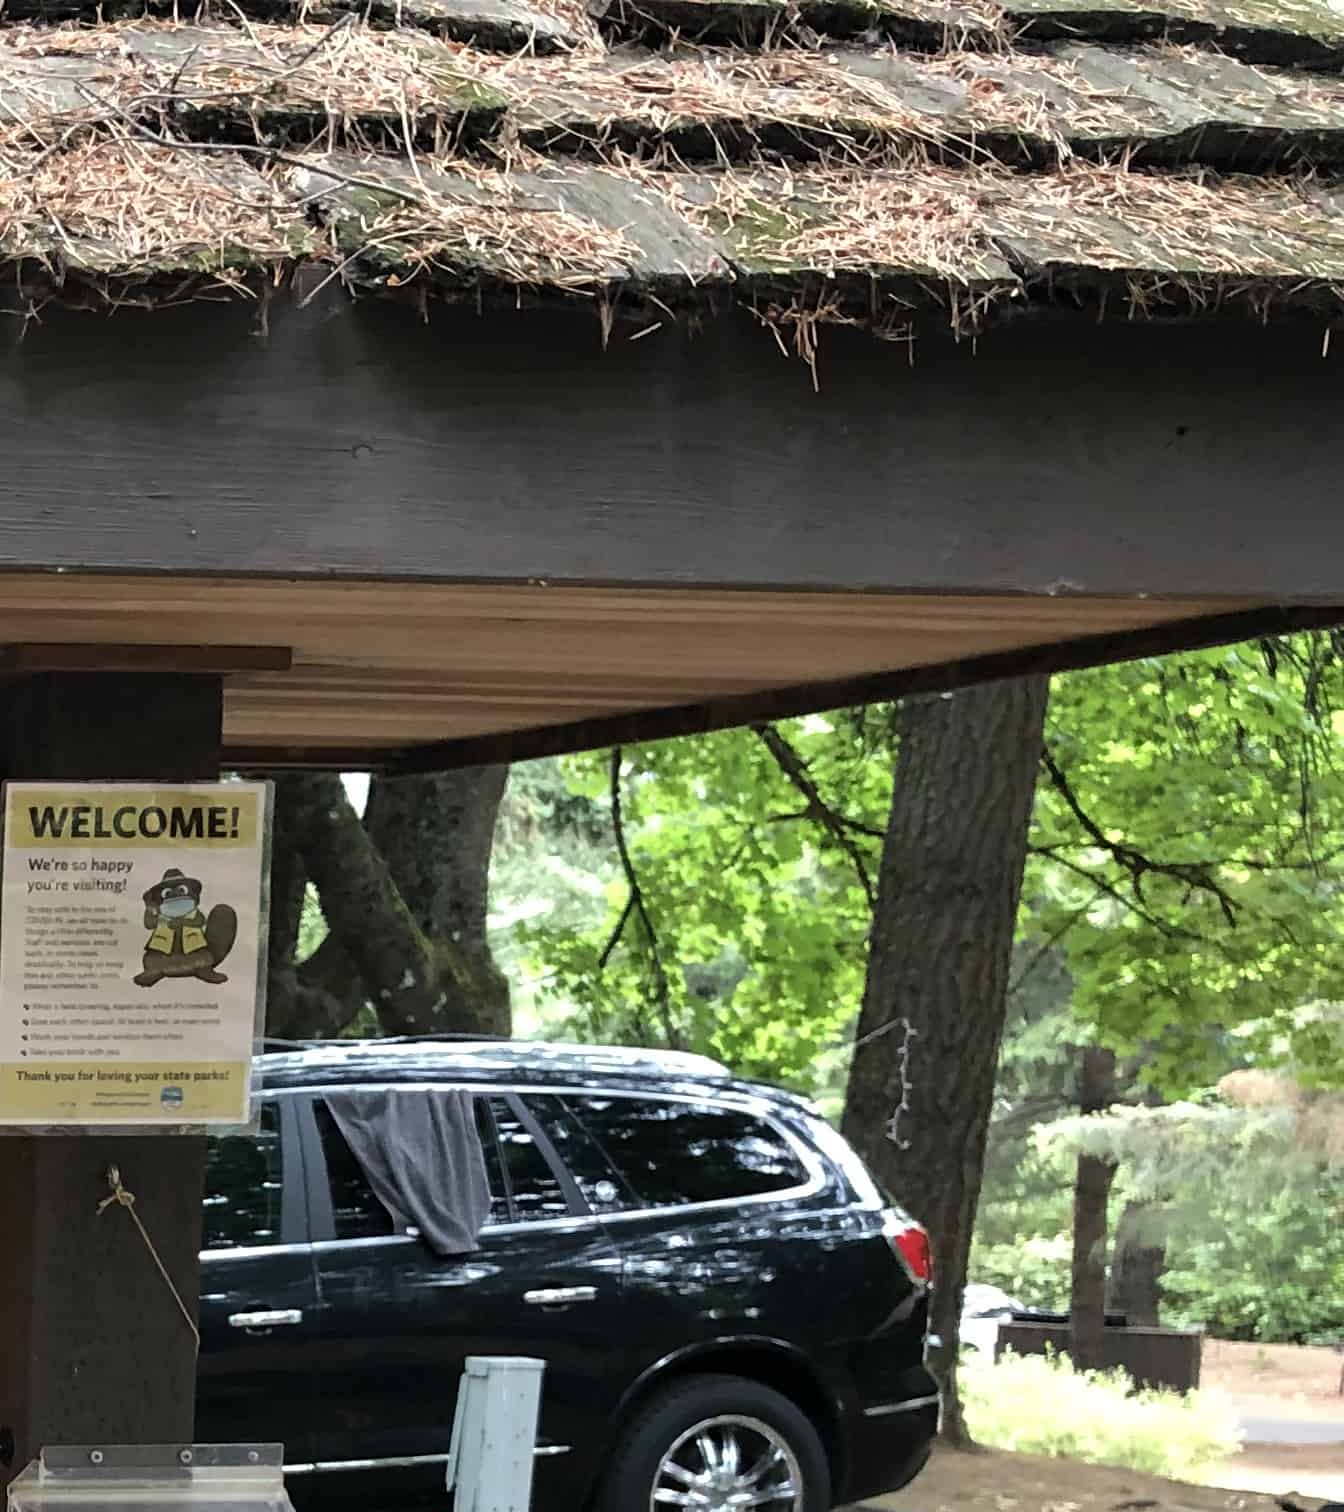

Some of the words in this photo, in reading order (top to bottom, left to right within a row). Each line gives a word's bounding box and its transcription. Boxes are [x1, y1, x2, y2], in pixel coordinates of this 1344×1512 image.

[28, 805, 240, 839] WELCOME!
[71, 861, 87, 871] so
[90, 857, 134, 874] happy
[72, 878, 128, 894] visiting!
[15, 1070, 52, 1081] Thank
[54, 1073, 76, 1083] you
[77, 1069, 95, 1081] for
[96, 1070, 133, 1084] loving
[134, 1072, 161, 1084] your
[162, 1071, 191, 1081] state
[193, 1071, 229, 1082] parks!
